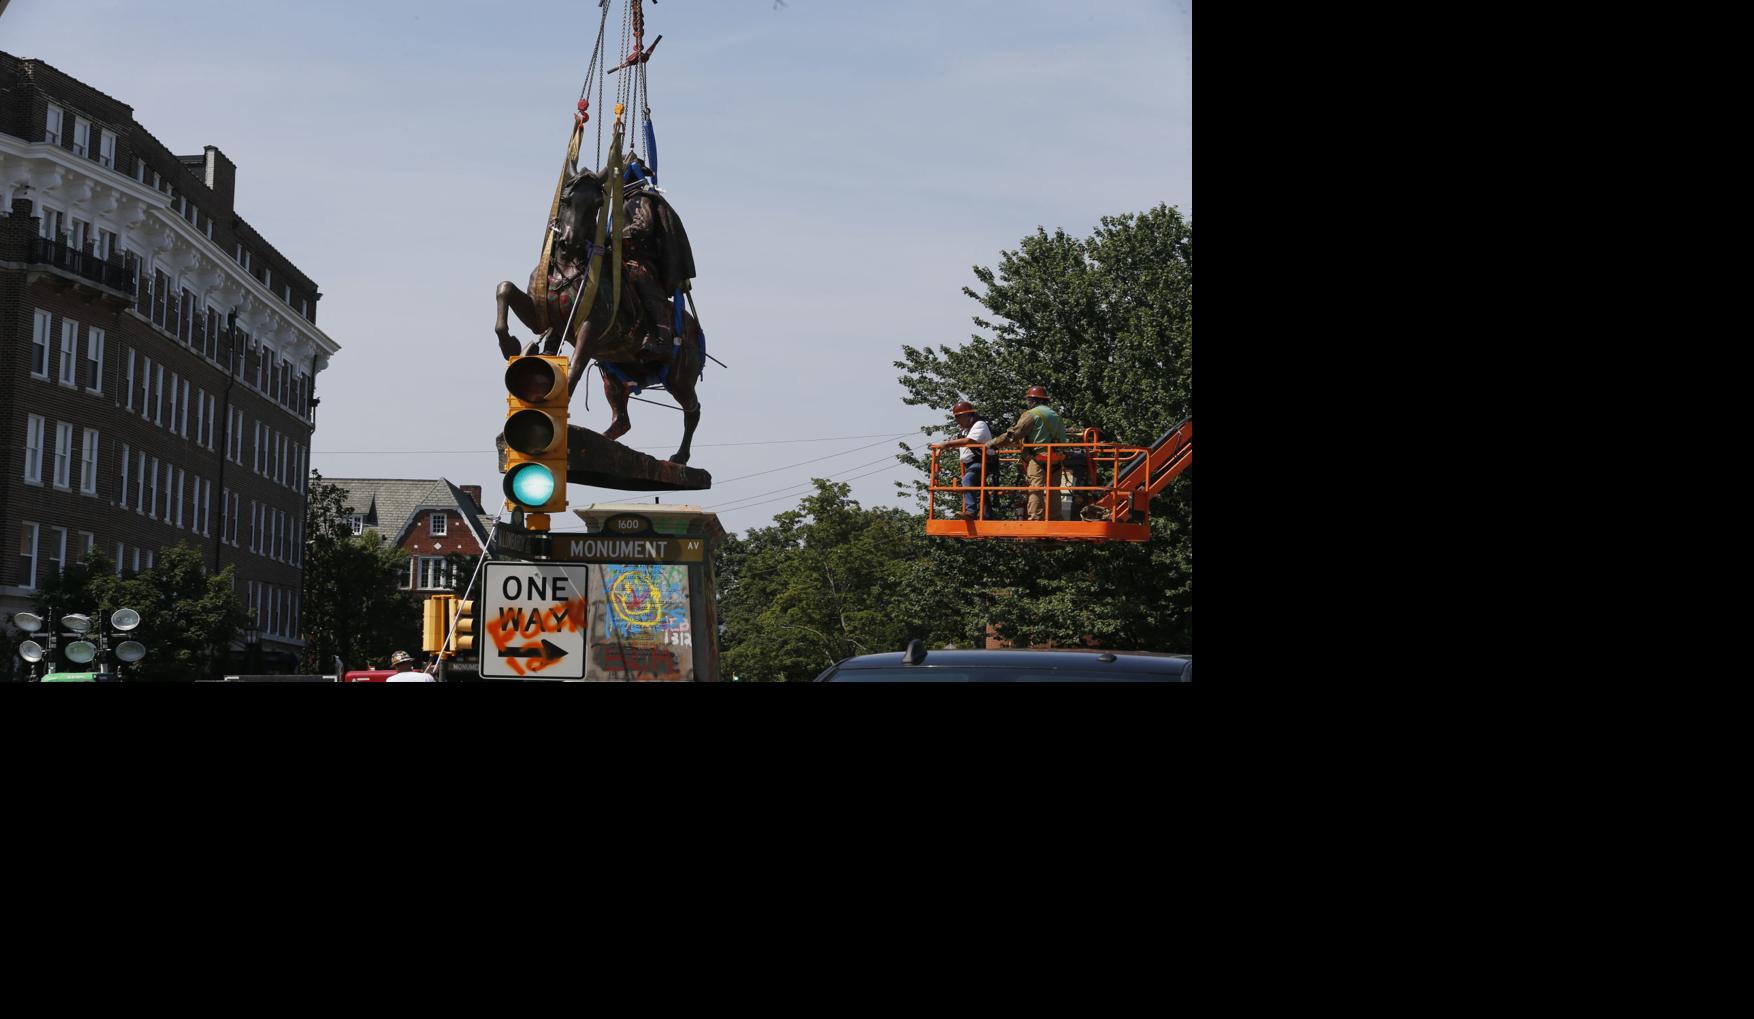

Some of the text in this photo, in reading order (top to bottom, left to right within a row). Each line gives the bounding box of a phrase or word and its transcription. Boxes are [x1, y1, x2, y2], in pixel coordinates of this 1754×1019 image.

[618, 519, 640, 529] 1600
[570, 539, 700, 558] MONUMENT AV
[502, 575, 569, 601] ONE
[499, 606, 569, 633] WAY
[452, 663, 480, 671] MONUME
